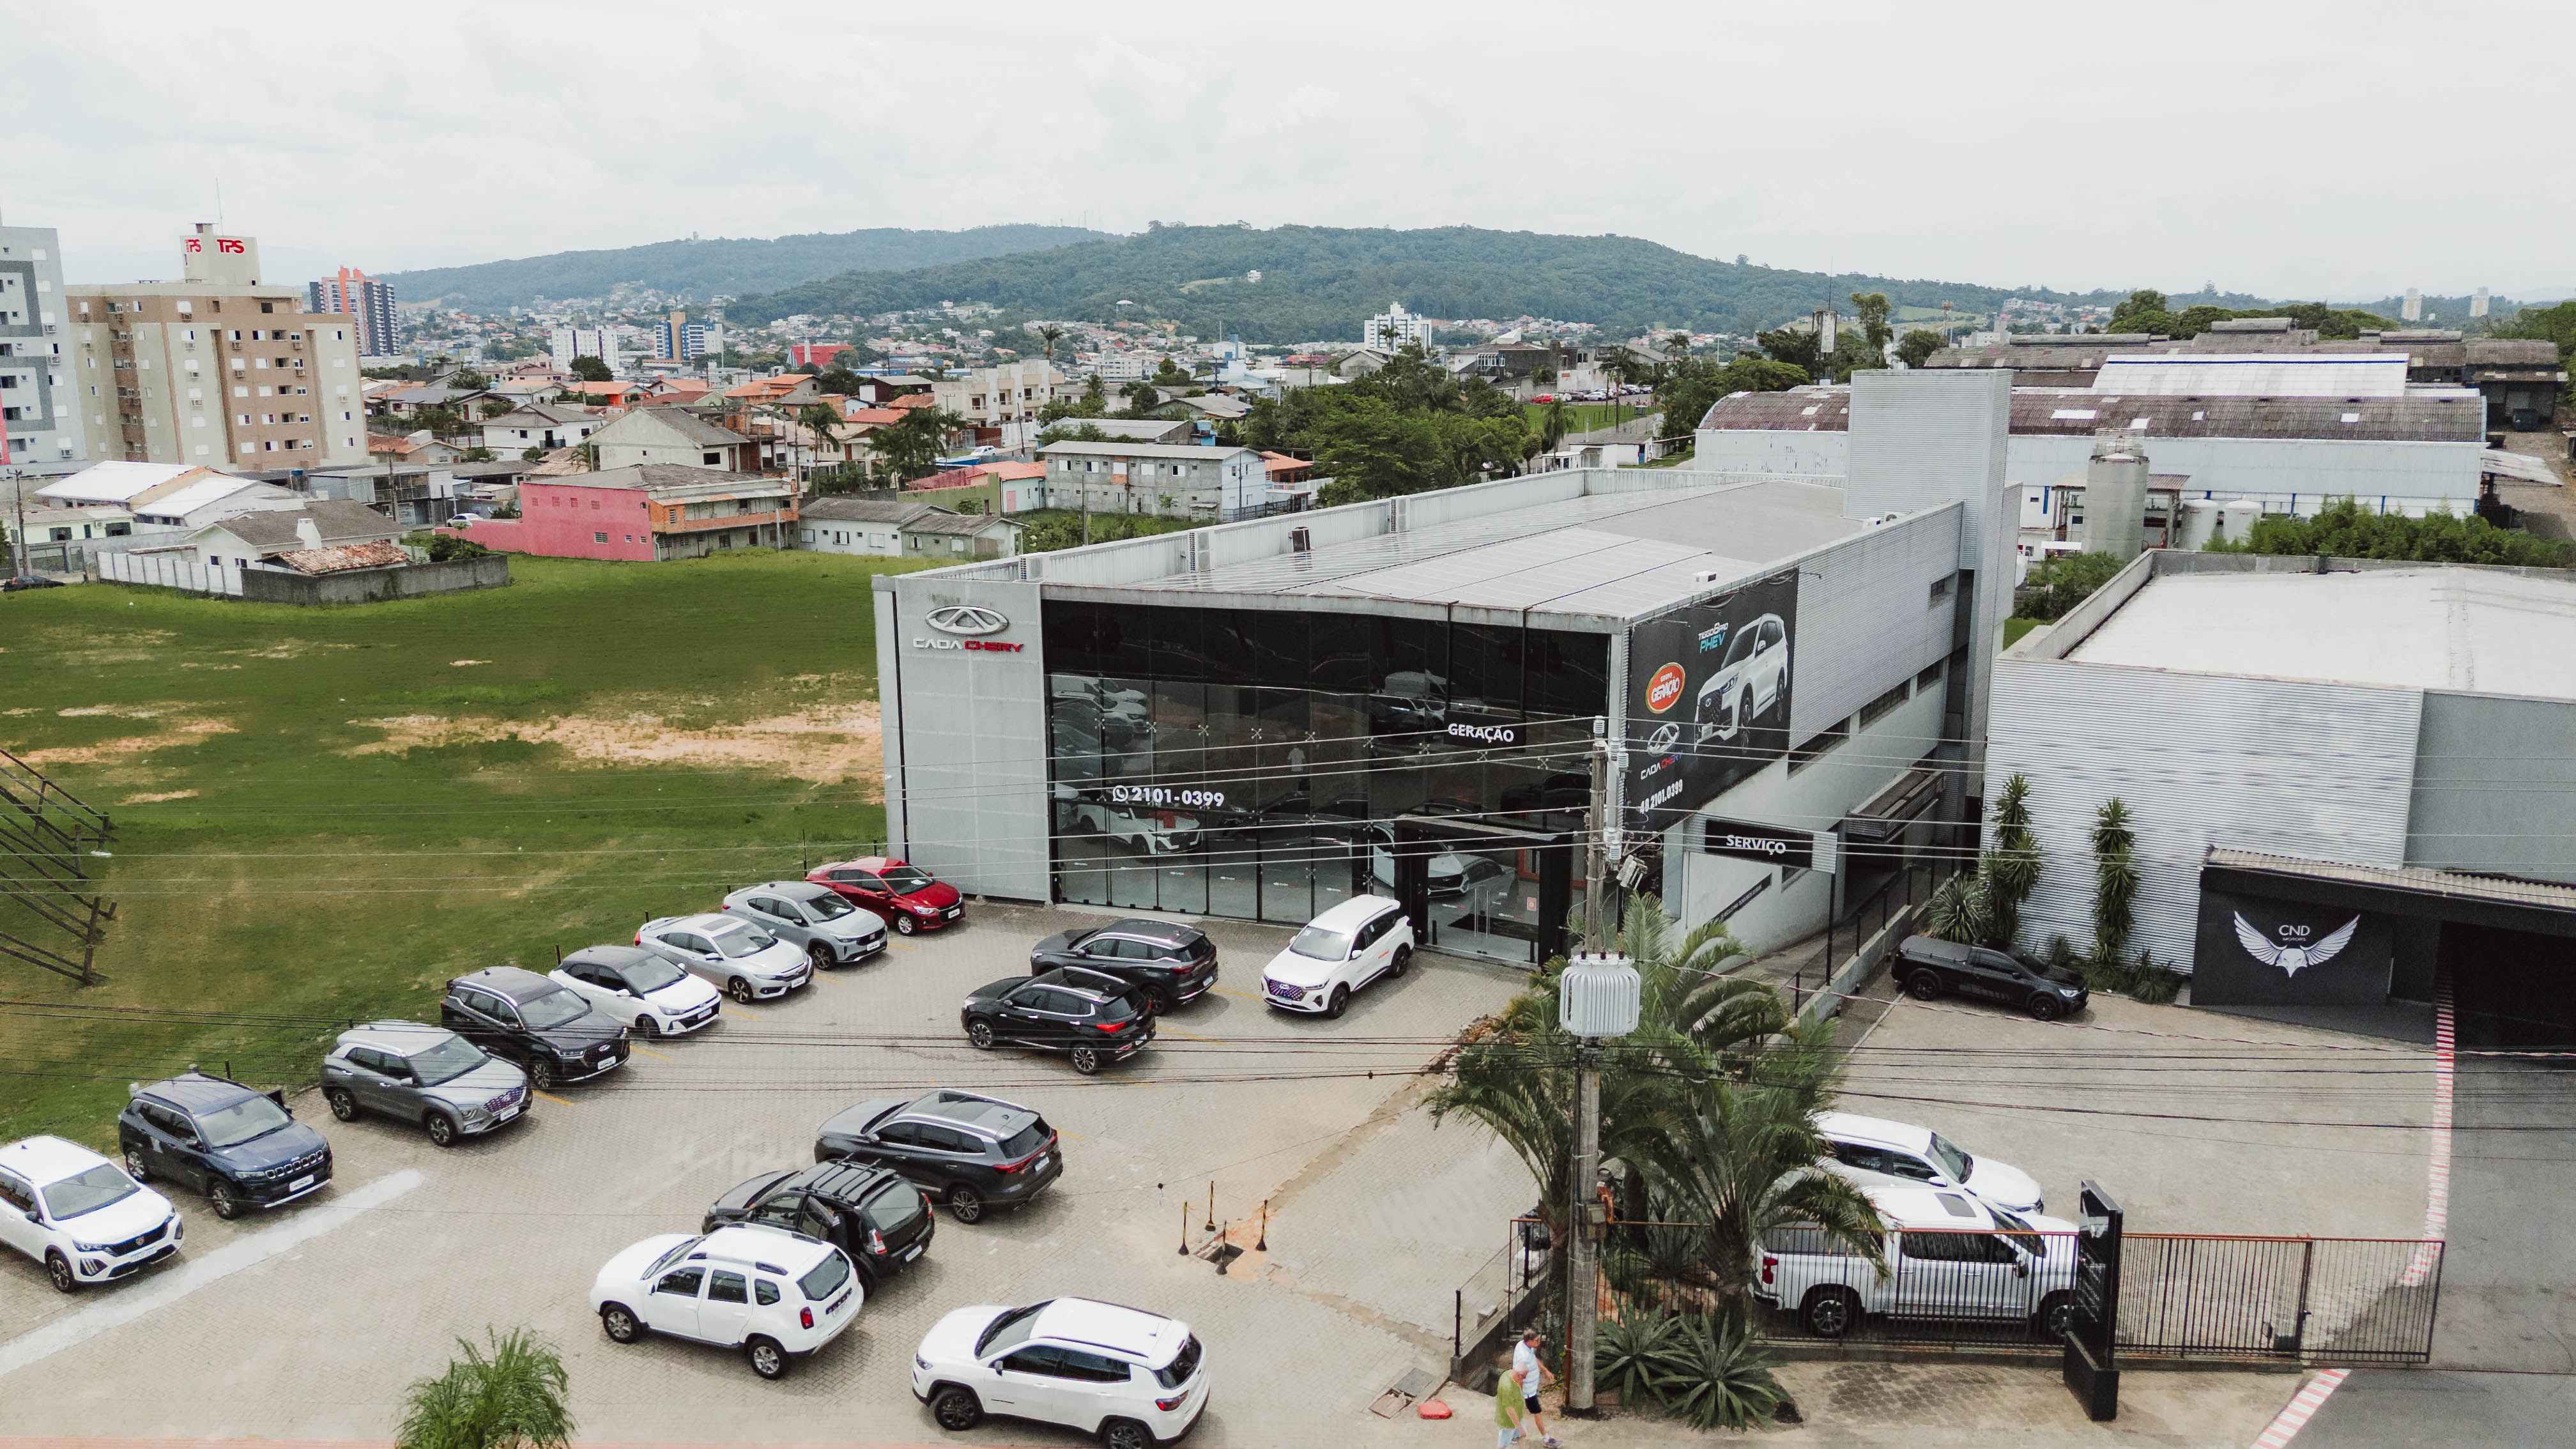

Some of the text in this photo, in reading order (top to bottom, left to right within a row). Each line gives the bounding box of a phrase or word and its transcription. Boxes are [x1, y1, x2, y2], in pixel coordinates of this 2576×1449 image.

[217, 239, 245, 254] TPS
[913, 638, 1024, 652] CAOA CHERY
[1699, 631, 1726, 654] PHEV
[1652, 677, 1680, 703] GERAÇÃO
[1448, 723, 1514, 743] GERAÇÃO
[1641, 762, 1661, 780] CAOA
[1132, 786, 1225, 807] 2101-0399
[1650, 779, 1683, 809] 2101.0399
[1726, 834, 1786, 855] SERVIÇO
[2278, 924, 2311, 937] CND
